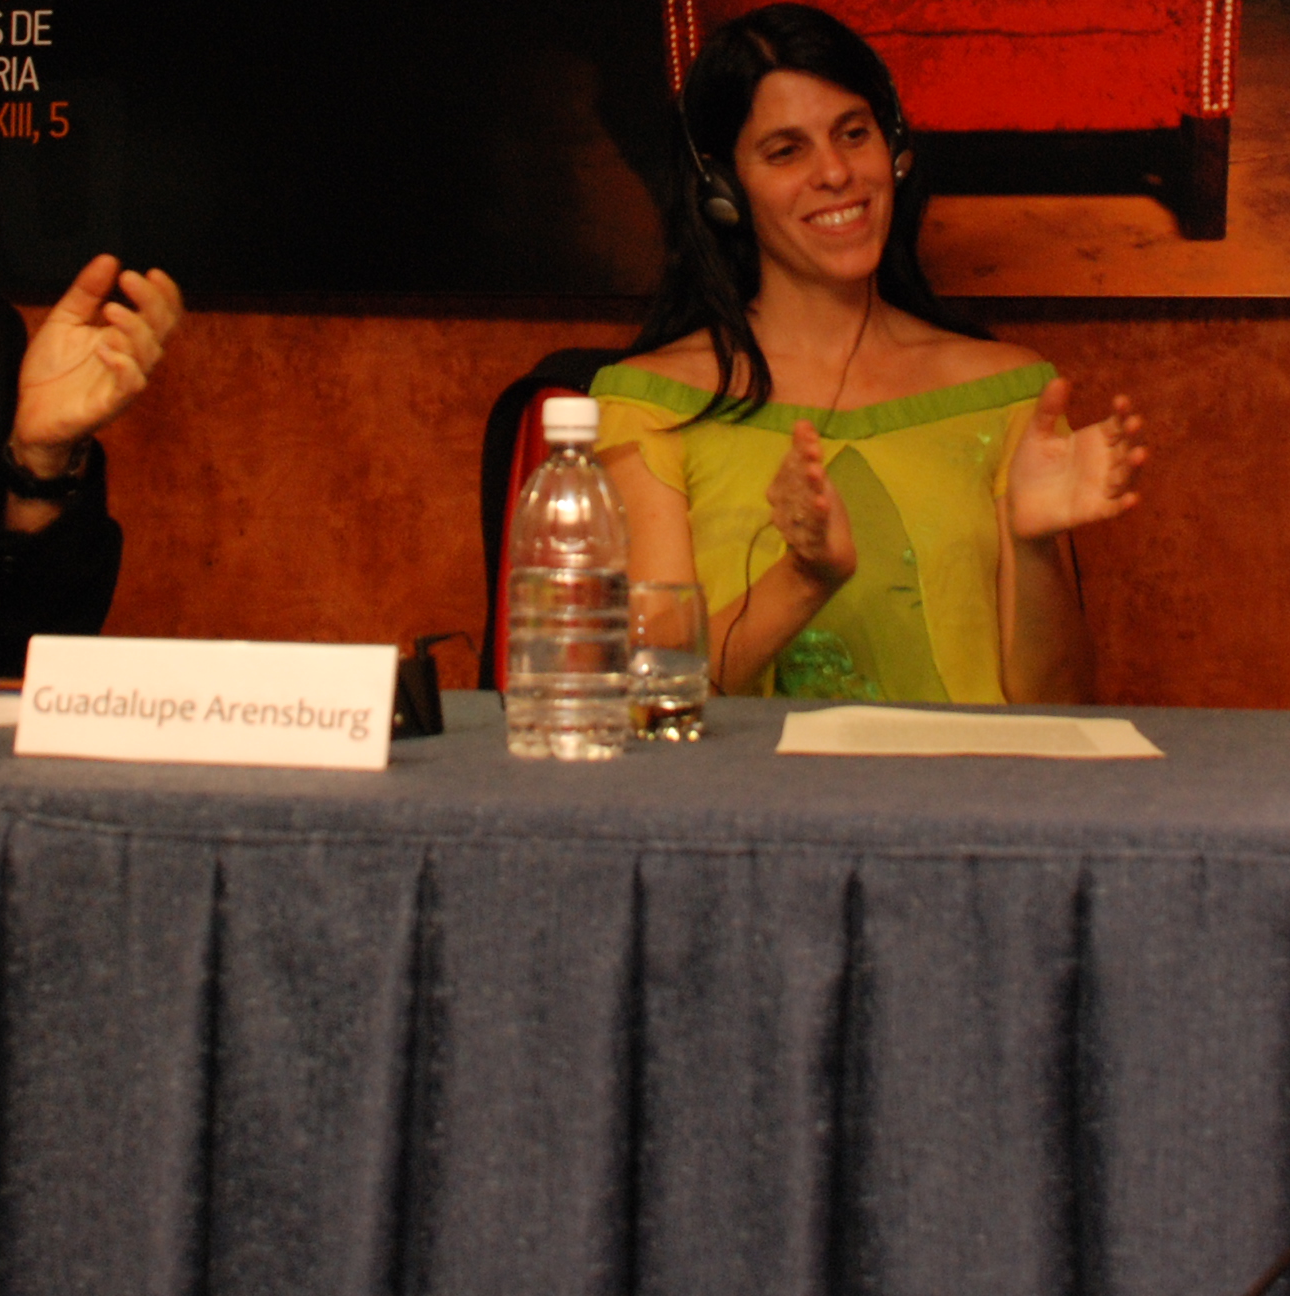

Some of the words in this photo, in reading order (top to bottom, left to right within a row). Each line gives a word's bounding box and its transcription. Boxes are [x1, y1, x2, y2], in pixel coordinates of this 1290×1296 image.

[11, 10, 53, 45] DE
[49, 101, 69, 138] 5
[32, 685, 196, 729] Guadalupe
[203, 694, 372, 742] Arensburg
